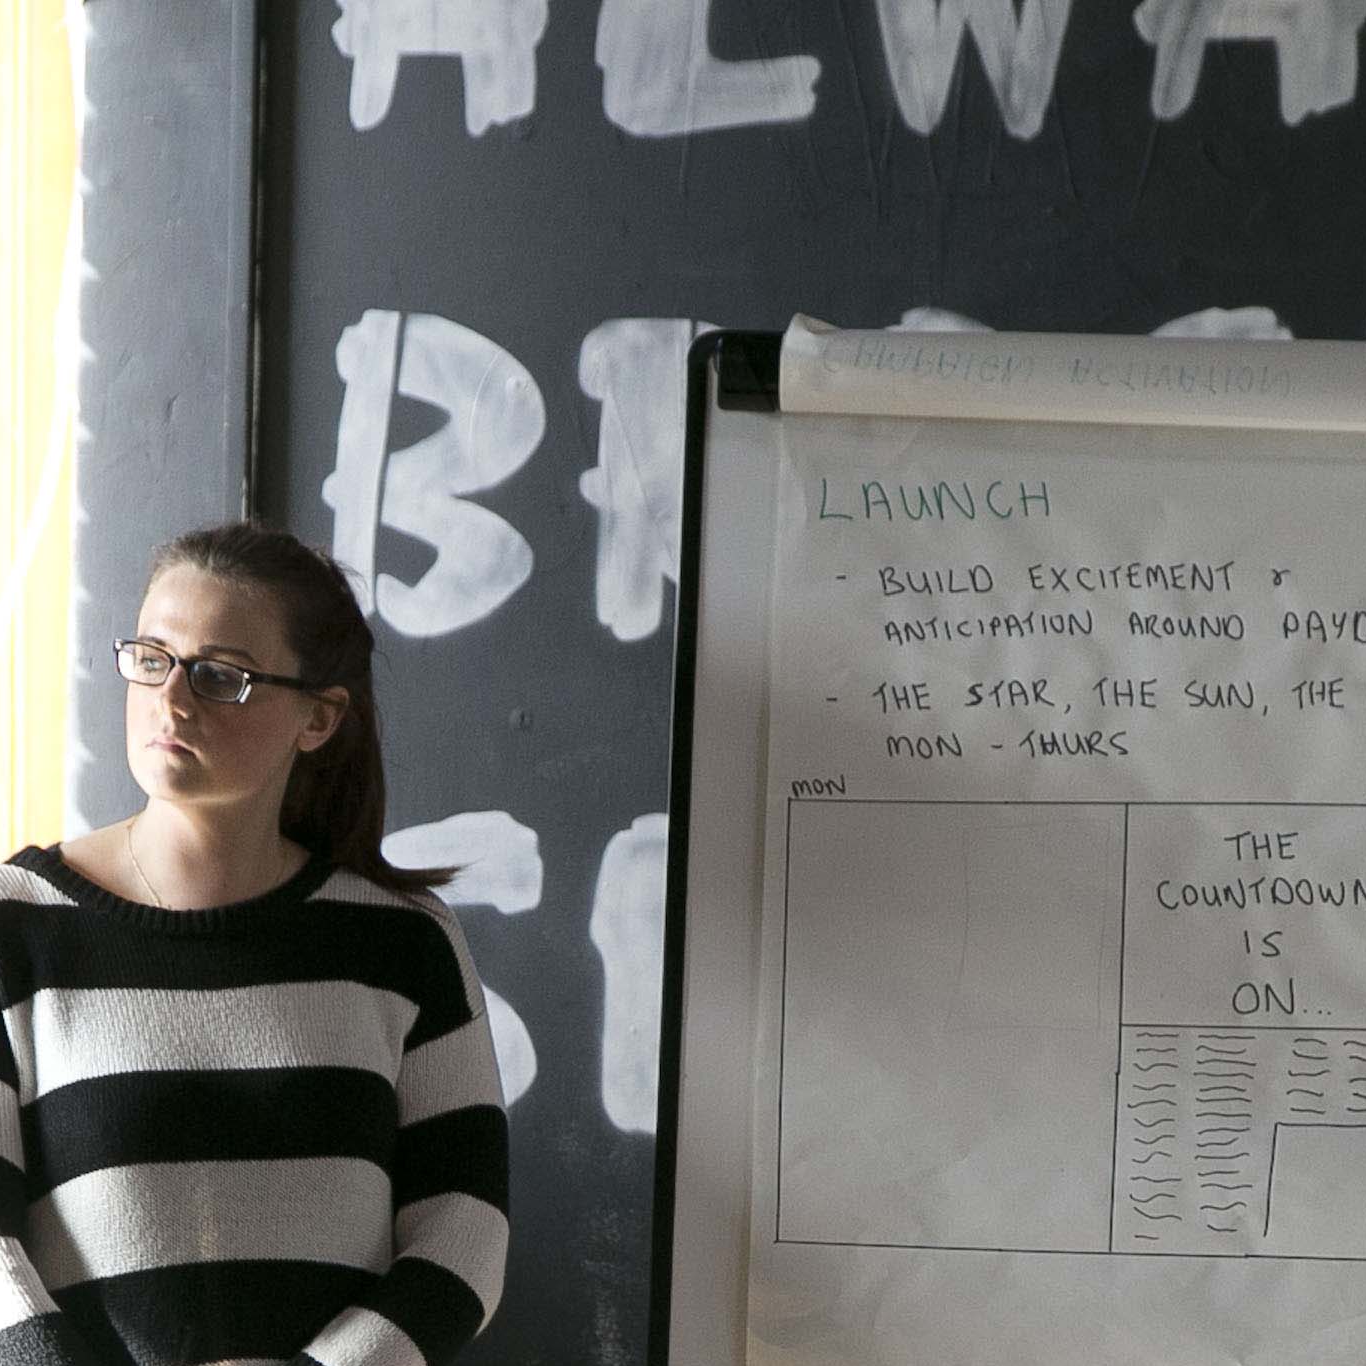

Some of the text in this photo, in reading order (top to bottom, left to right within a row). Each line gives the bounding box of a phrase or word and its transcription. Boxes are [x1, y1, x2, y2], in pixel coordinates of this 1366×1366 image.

[819, 477, 1050, 522] LAUNCH
[878, 564, 994, 597] BUILD
[1027, 560, 1235, 594] EXCITEMENT
[883, 609, 1093, 647] ANTICIPATION
[1127, 611, 1245, 642] AROUND
[871, 681, 932, 714] THE
[964, 678, 1072, 715] STAR,
[1091, 676, 1158, 710] THE
[1183, 678, 1269, 717] SUN,
[1291, 676, 1345, 711] THE
[885, 732, 963, 760] MON
[1018, 729, 1129, 759] THURS
[1223, 830, 1299, 862] THE
[1243, 929, 1284, 958] IS
